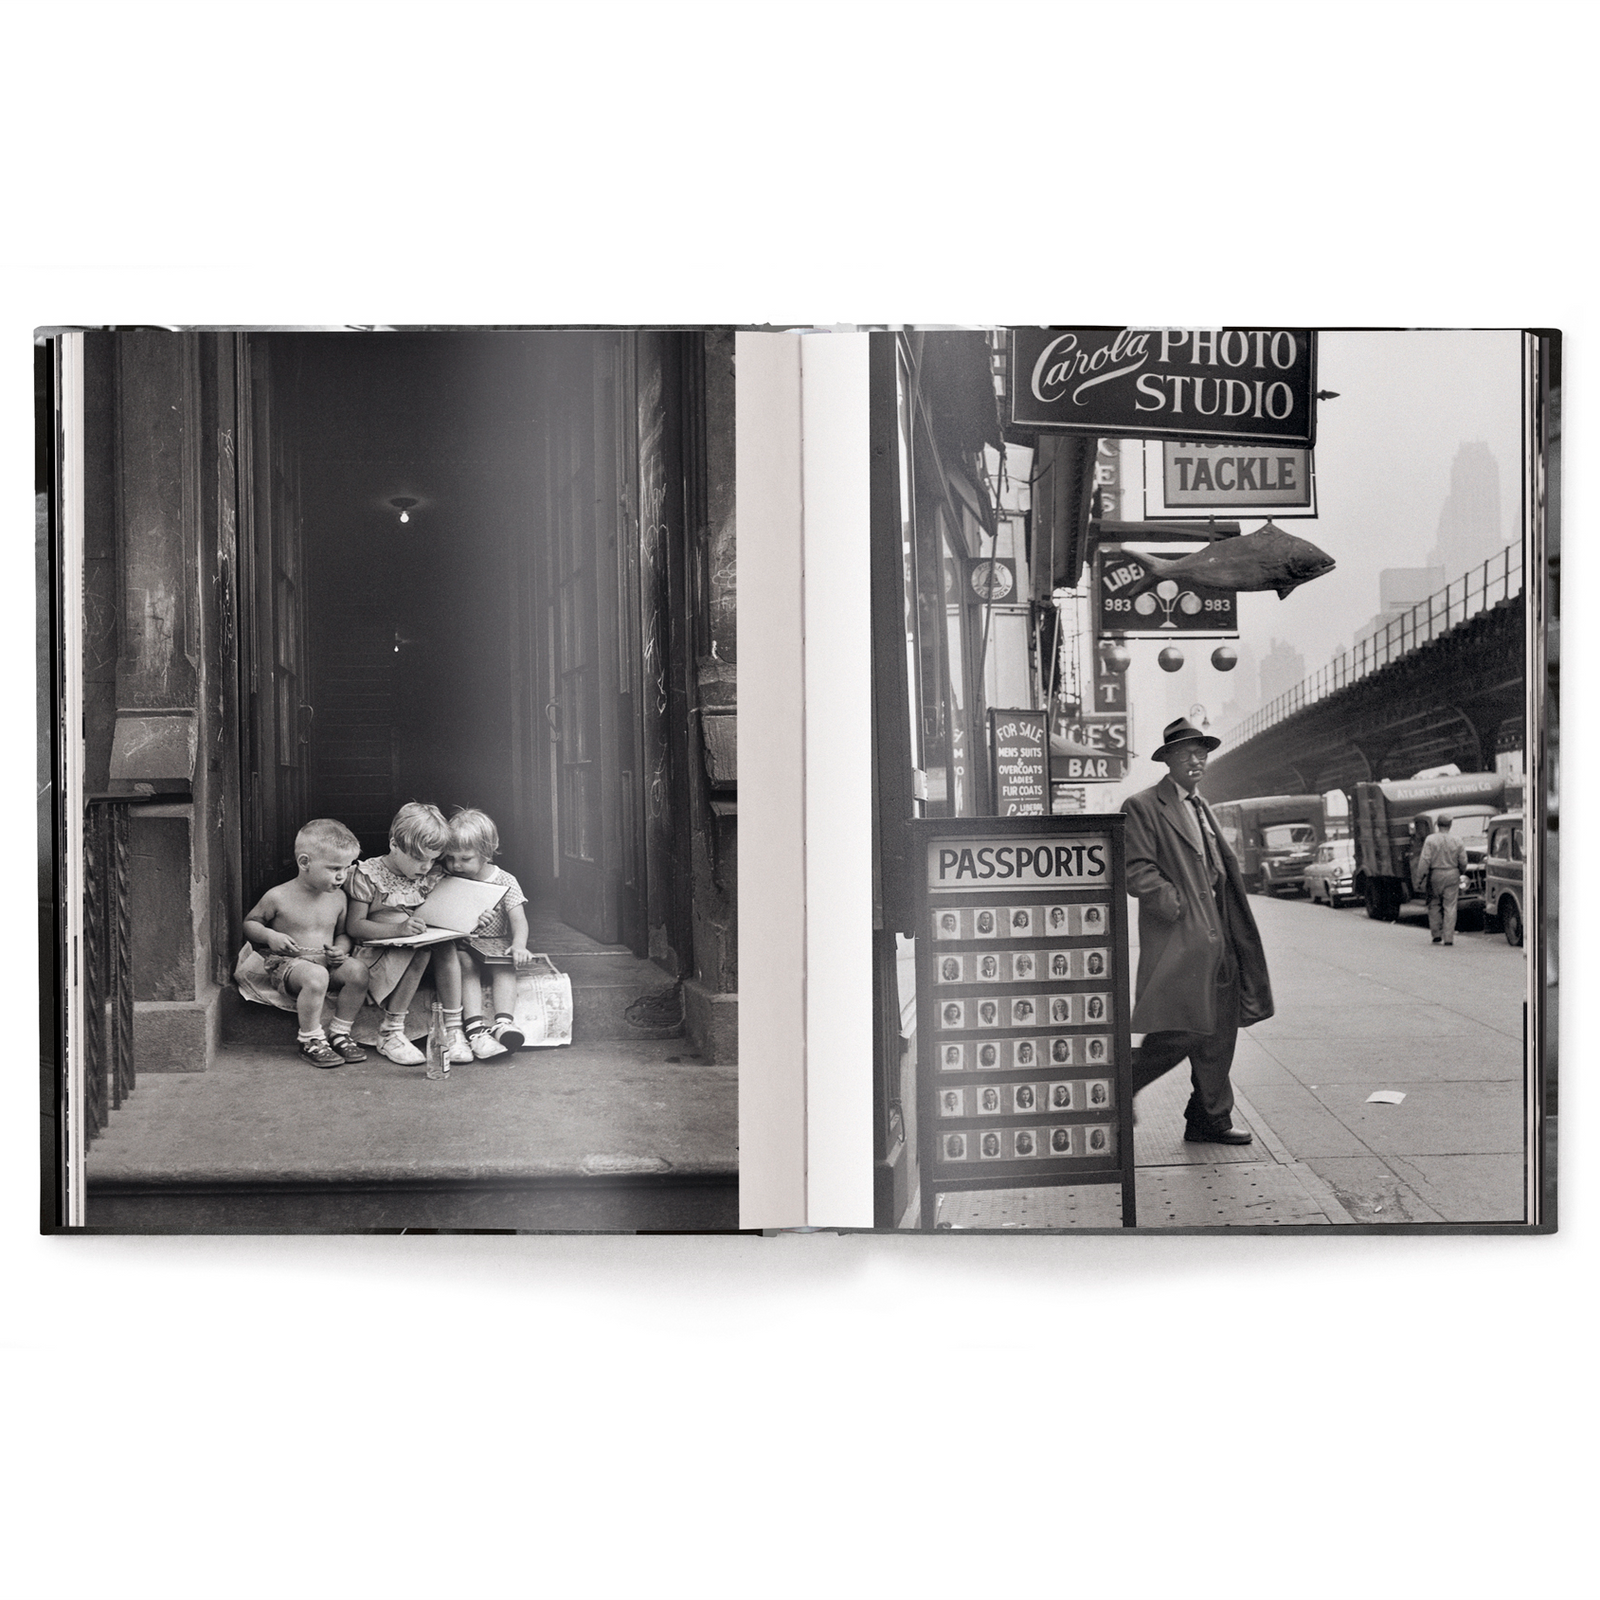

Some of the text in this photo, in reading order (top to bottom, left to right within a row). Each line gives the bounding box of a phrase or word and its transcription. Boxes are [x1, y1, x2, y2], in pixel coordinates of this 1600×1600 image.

[1031, 331, 1297, 405] Carola PHOTO
[1135, 373, 1294, 419] STUDIO
[1174, 457, 1296, 491] TACKLE
[1104, 598, 1231, 611] 983 983
[997, 722, 1044, 743] FOR SALE
[998, 747, 1042, 757] MENS SUITS
[999, 765, 1043, 775] OVERCOATS
[1068, 759, 1108, 777] BAR
[1009, 776, 1034, 784] LADIES
[1002, 785, 1043, 796] FUR COATS
[1397, 786, 1437, 799] ATLANTIC
[939, 845, 1106, 880] PASSPORTS
